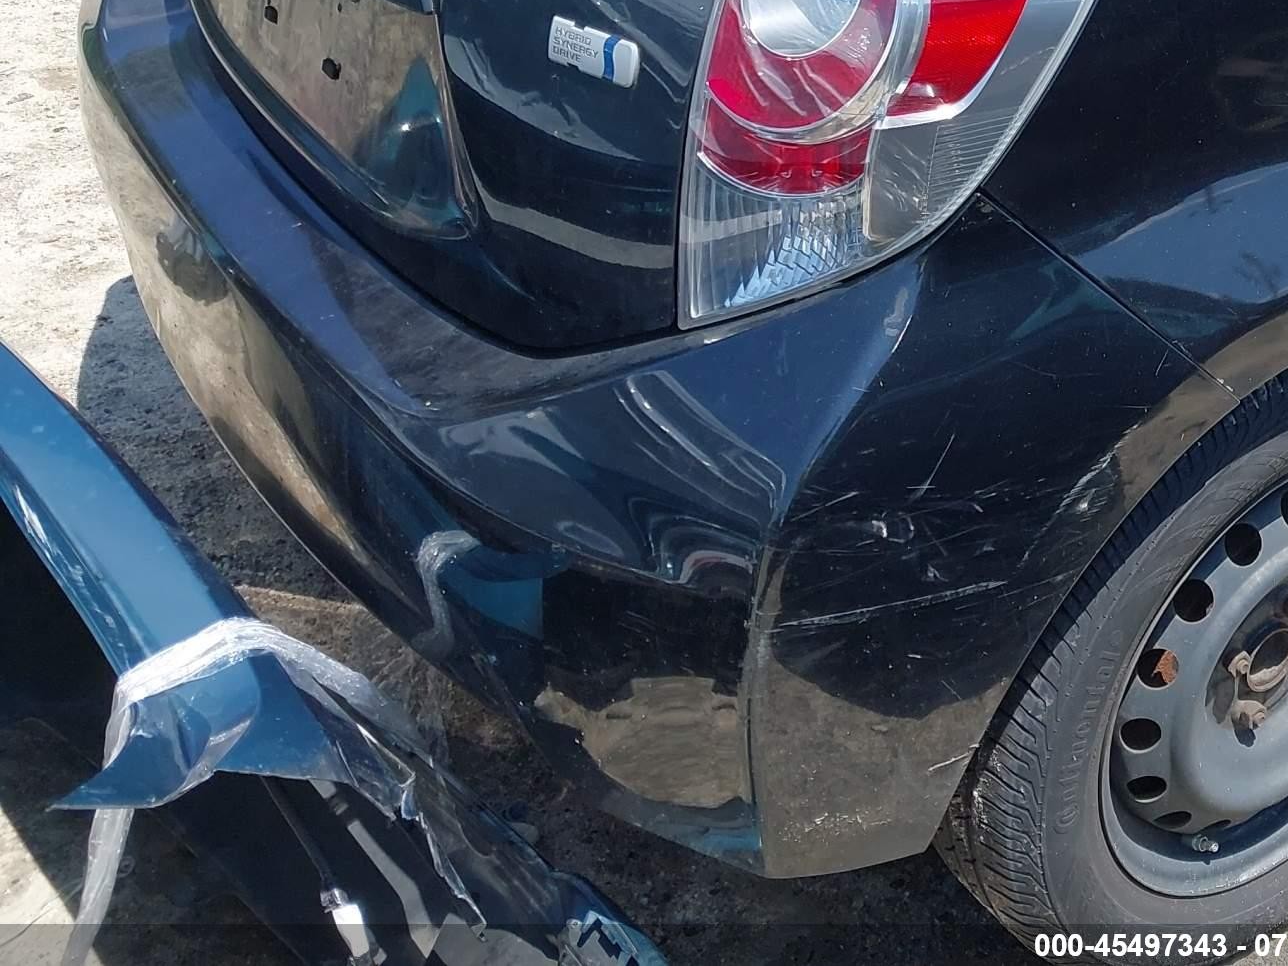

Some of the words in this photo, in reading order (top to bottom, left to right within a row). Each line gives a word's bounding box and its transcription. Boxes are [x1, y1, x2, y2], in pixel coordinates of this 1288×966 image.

[556, 27, 592, 45] HYBRID
[553, 46, 582, 63] DRIVE
[554, 36, 599, 59] SYNERGY
